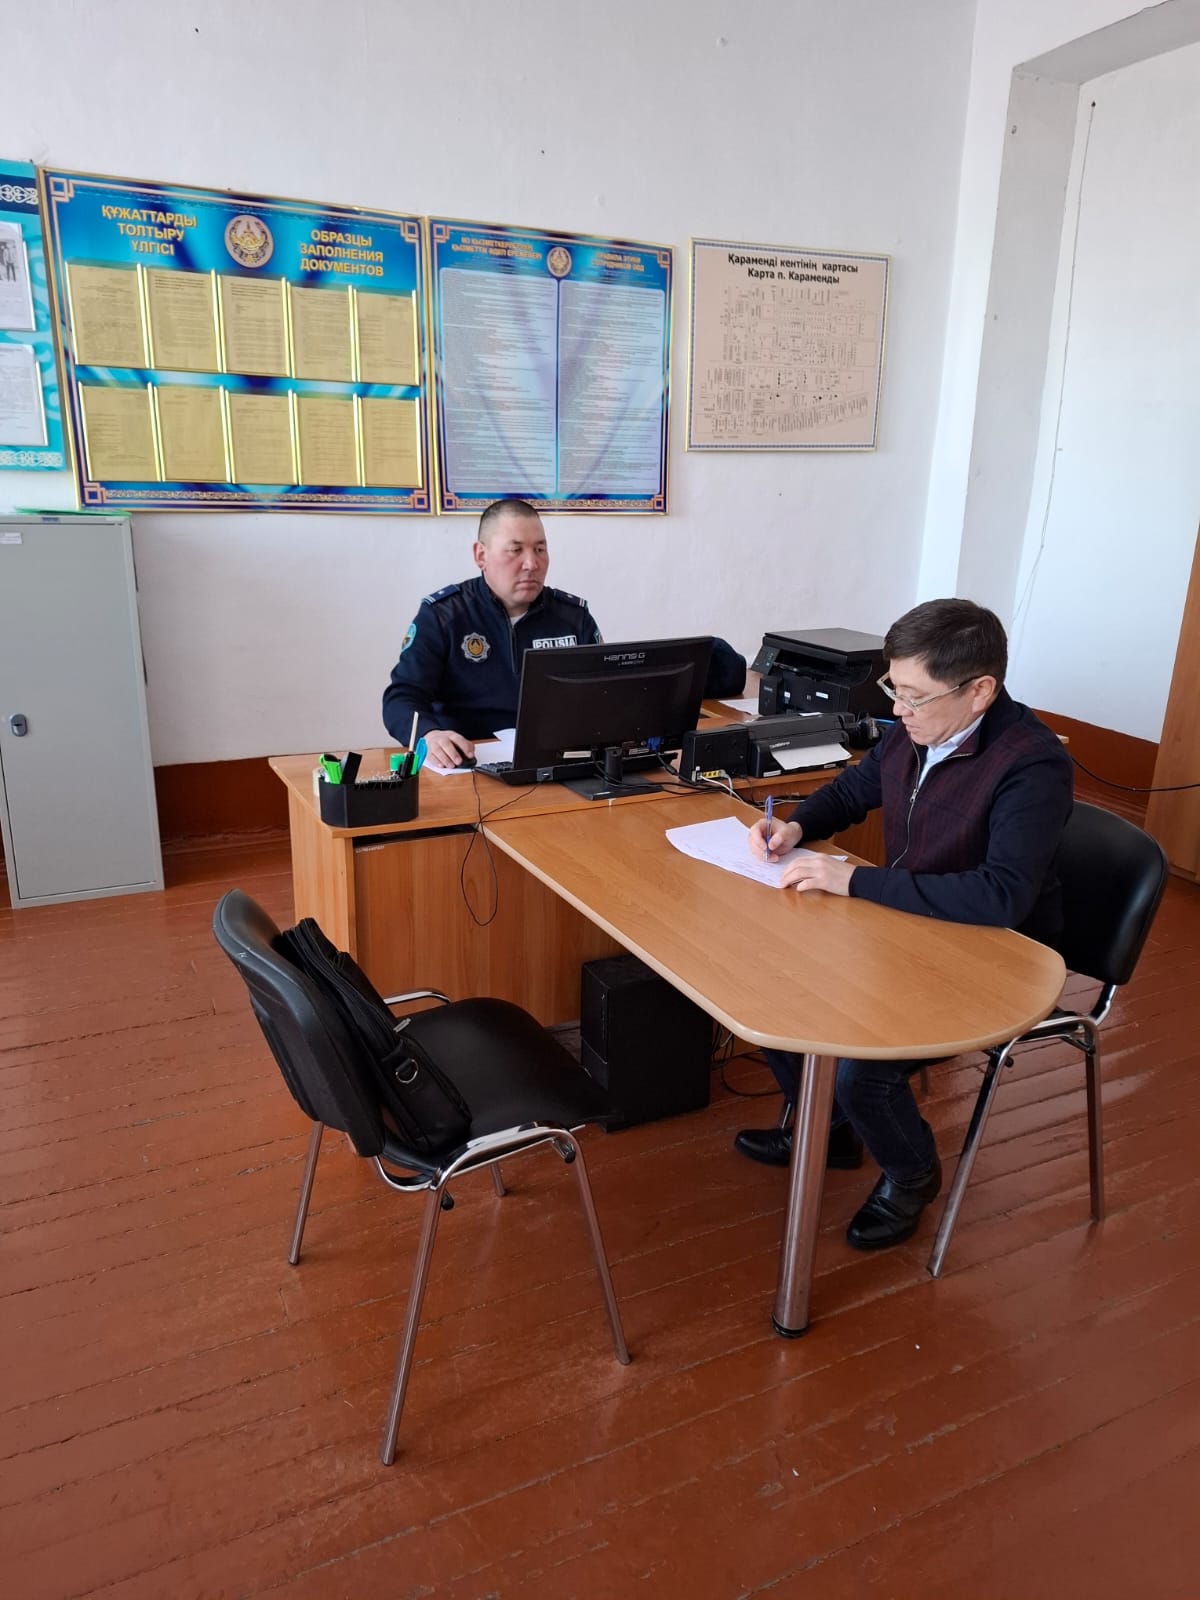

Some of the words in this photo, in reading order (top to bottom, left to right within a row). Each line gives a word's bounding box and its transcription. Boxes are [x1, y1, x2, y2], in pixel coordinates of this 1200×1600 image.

[101, 204, 197, 228] ҚҰЖАТТАРДЫ
[117, 222, 184, 242] ТОЛТЫРУ
[310, 229, 372, 248] ОБРАЗЦЫ
[131, 240, 174, 256] ҮЛГІСІ
[300, 243, 383, 262] ЗАПОЛНЕНИЯ
[300, 258, 384, 277] ДОКУМЕНТОВ
[728, 253, 777, 267] Қараменді
[780, 259, 817, 271] кентінің
[822, 263, 858, 274] картасы
[747, 267, 775, 280] Карта
[777, 271, 786, 280] п.
[788, 270, 840, 285] Караменды
